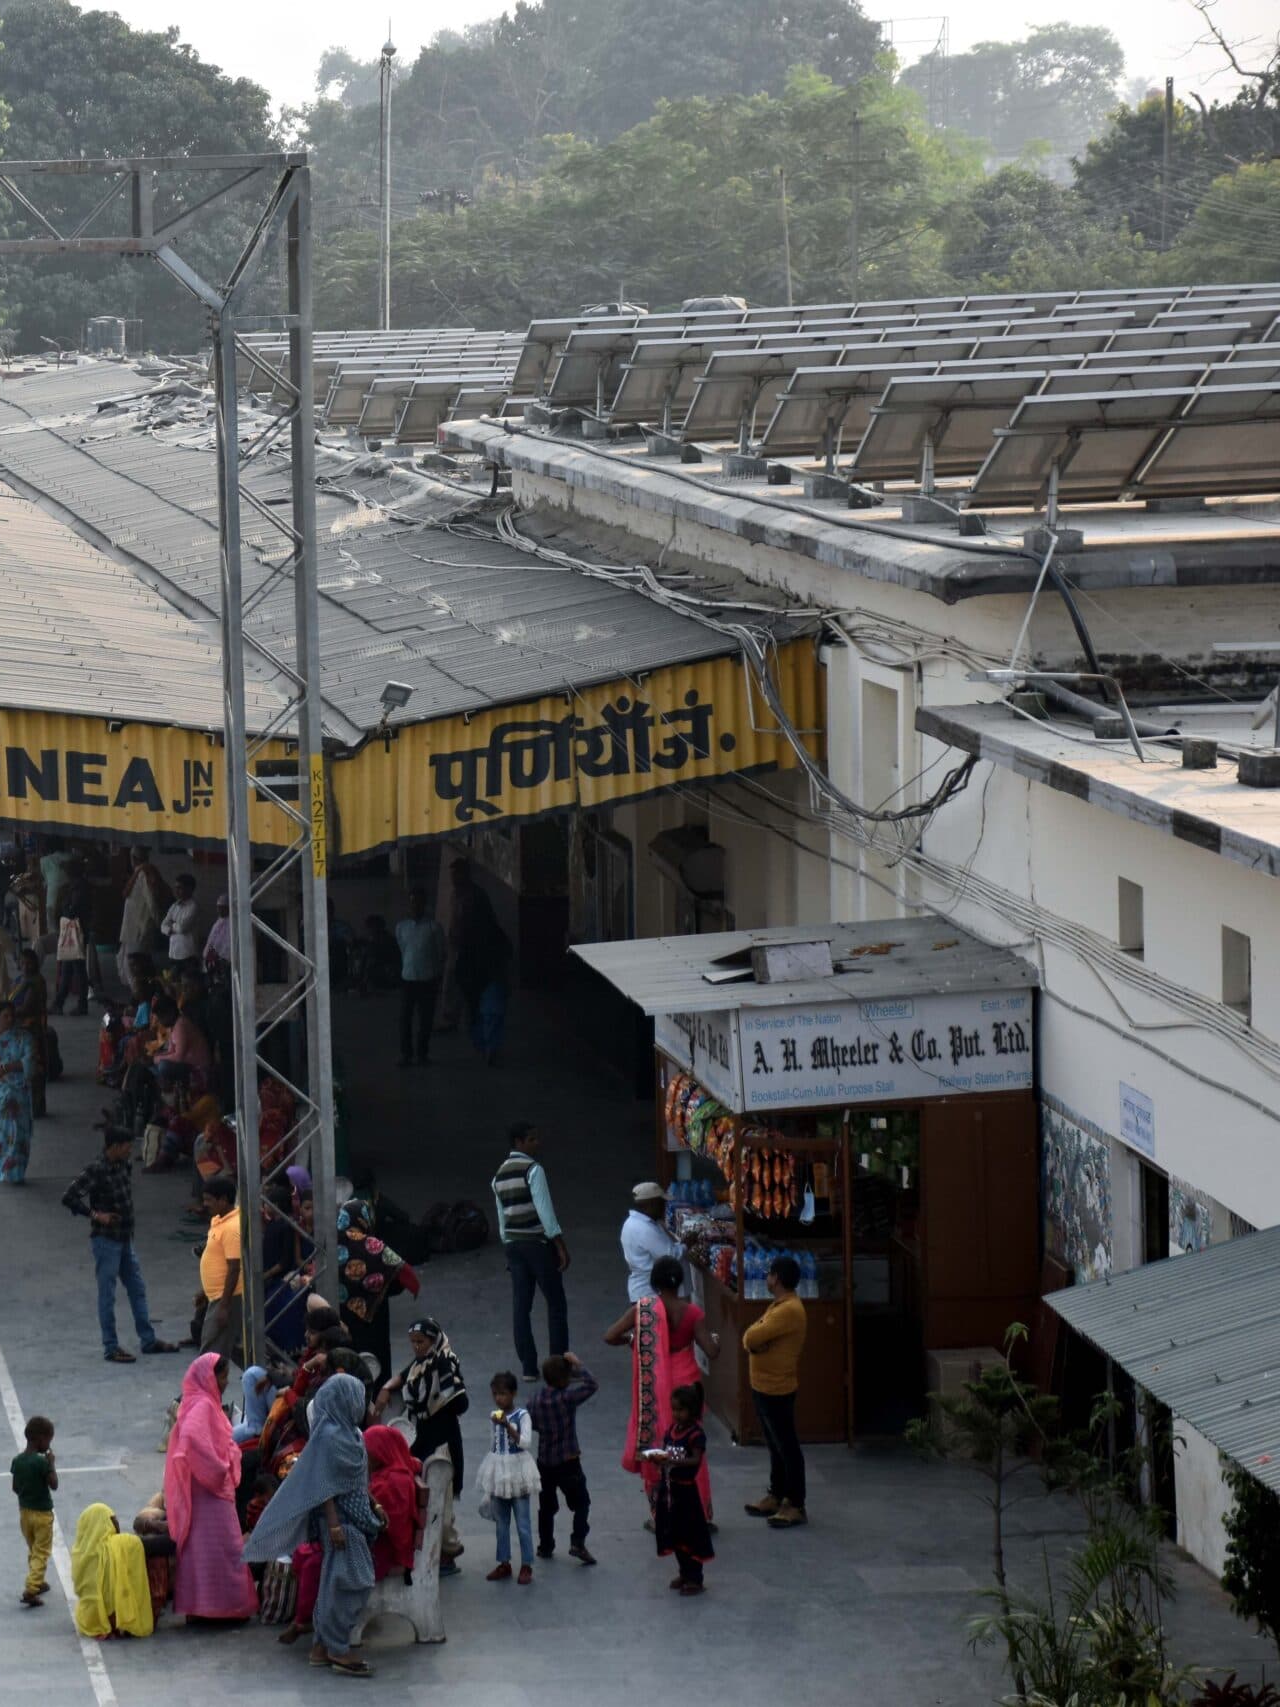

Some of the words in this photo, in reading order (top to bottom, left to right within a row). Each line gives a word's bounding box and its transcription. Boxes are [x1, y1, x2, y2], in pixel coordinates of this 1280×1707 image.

[863, 1001, 908, 1017] Wheeler
[744, 1018, 753, 1030] In
[755, 1016, 785, 1030] Service
[787, 1016, 795, 1028] of
[797, 1015, 813, 1026] The
[815, 1012, 842, 1025] Nation
[752, 1041, 773, 1074] A.
[888, 1032, 904, 1064] &
[911, 1029, 942, 1062] Co.
[992, 1021, 1030, 1056] Ltd.
[974, 1072, 1004, 1086] Station
[837, 1082, 873, 1100] Purpose
[875, 1080, 896, 1093] Stall
